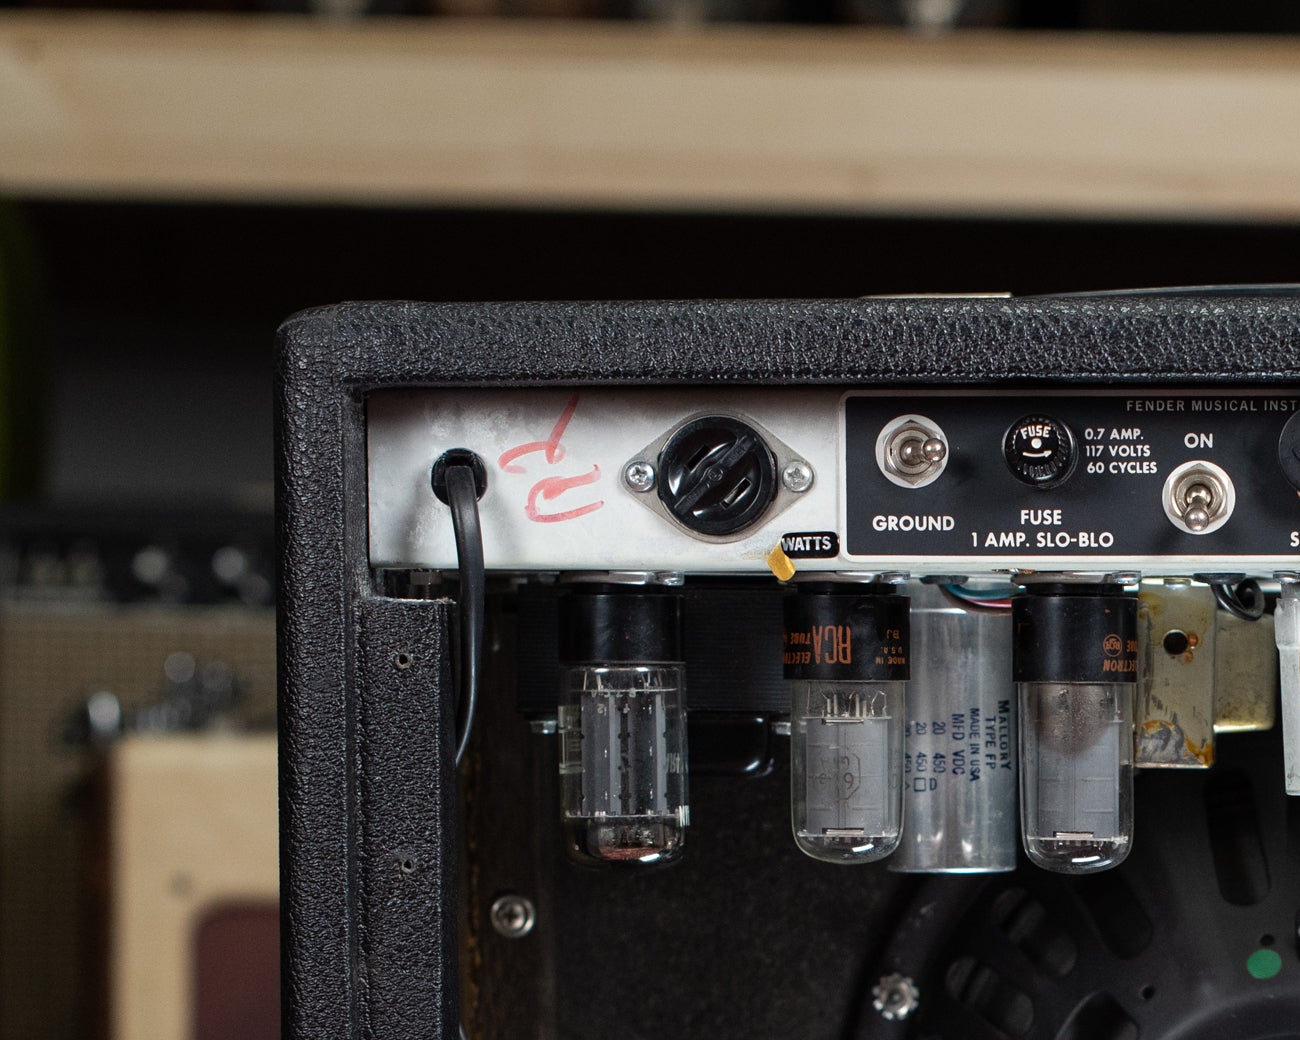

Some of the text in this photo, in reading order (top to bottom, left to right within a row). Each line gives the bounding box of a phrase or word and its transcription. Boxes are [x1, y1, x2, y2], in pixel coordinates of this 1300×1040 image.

[1126, 400, 1185, 411] FENDER
[1191, 400, 1258, 411] MUSICAL
[1020, 425, 1051, 440] FUSE
[1084, 428, 1144, 440] 0.7 AMP.
[1184, 433, 1213, 449] ON
[1086, 445, 1151, 457] 117 VOLTS
[1086, 462, 1158, 474] 60 CYCLES
[872, 515, 955, 532] GROUND
[1020, 509, 1062, 526] FUSE
[781, 535, 832, 551] WATTS
[971, 532, 1114, 548] 1 AMP. SLO-BLO
[812, 625, 852, 665] RCA
[985, 715, 997, 770] TYPE FP
[998, 700, 1012, 770] MALLORY
[915, 721, 927, 772] 20 450
[932, 721, 946, 774] 20 450
[951, 713, 965, 776] MFD VDC
[969, 707, 980, 782] MADE IN USA
